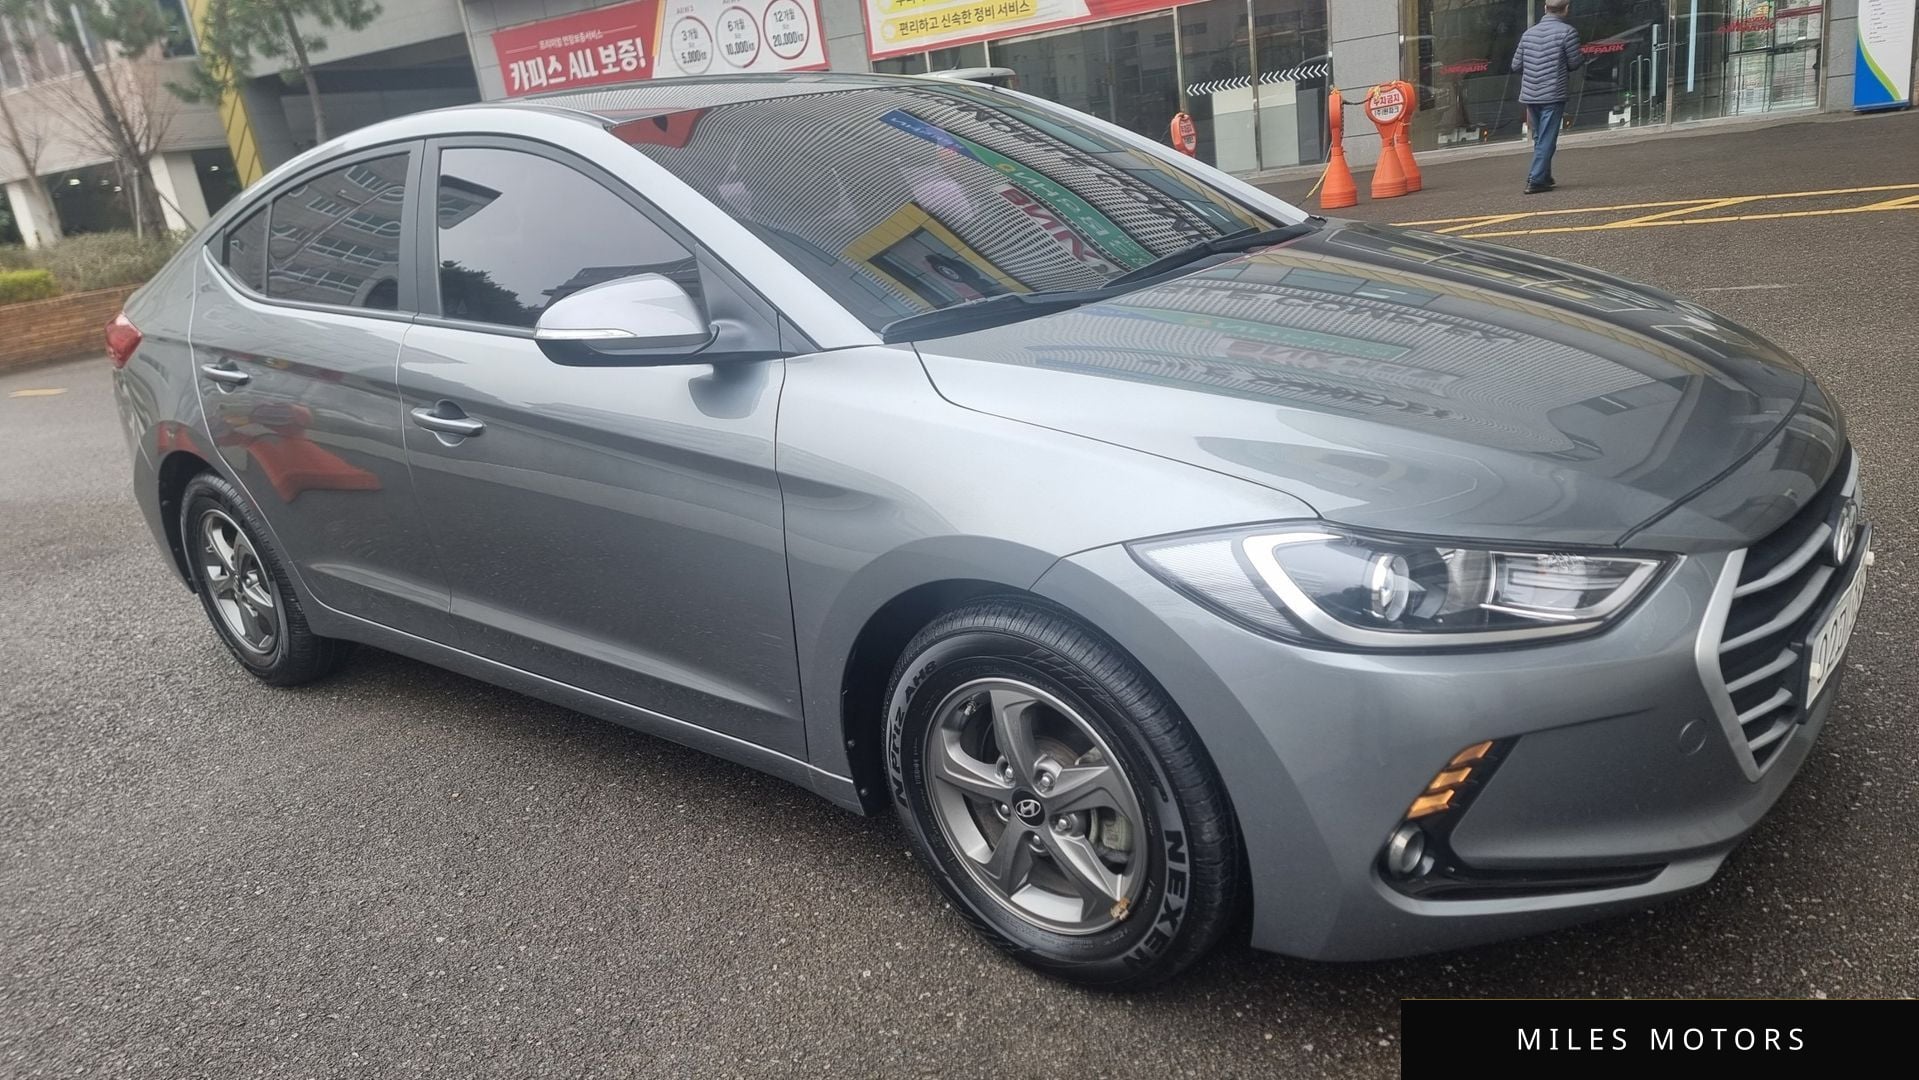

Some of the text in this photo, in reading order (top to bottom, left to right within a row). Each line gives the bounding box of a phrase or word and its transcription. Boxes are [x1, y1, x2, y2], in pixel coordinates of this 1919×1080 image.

[899, 2, 1030, 36] 편리하고 신속한 정비 서비스
[509, 37, 647, 91] 카피스 ALL 보증!
[1122, 829, 1187, 967] NEXEN
